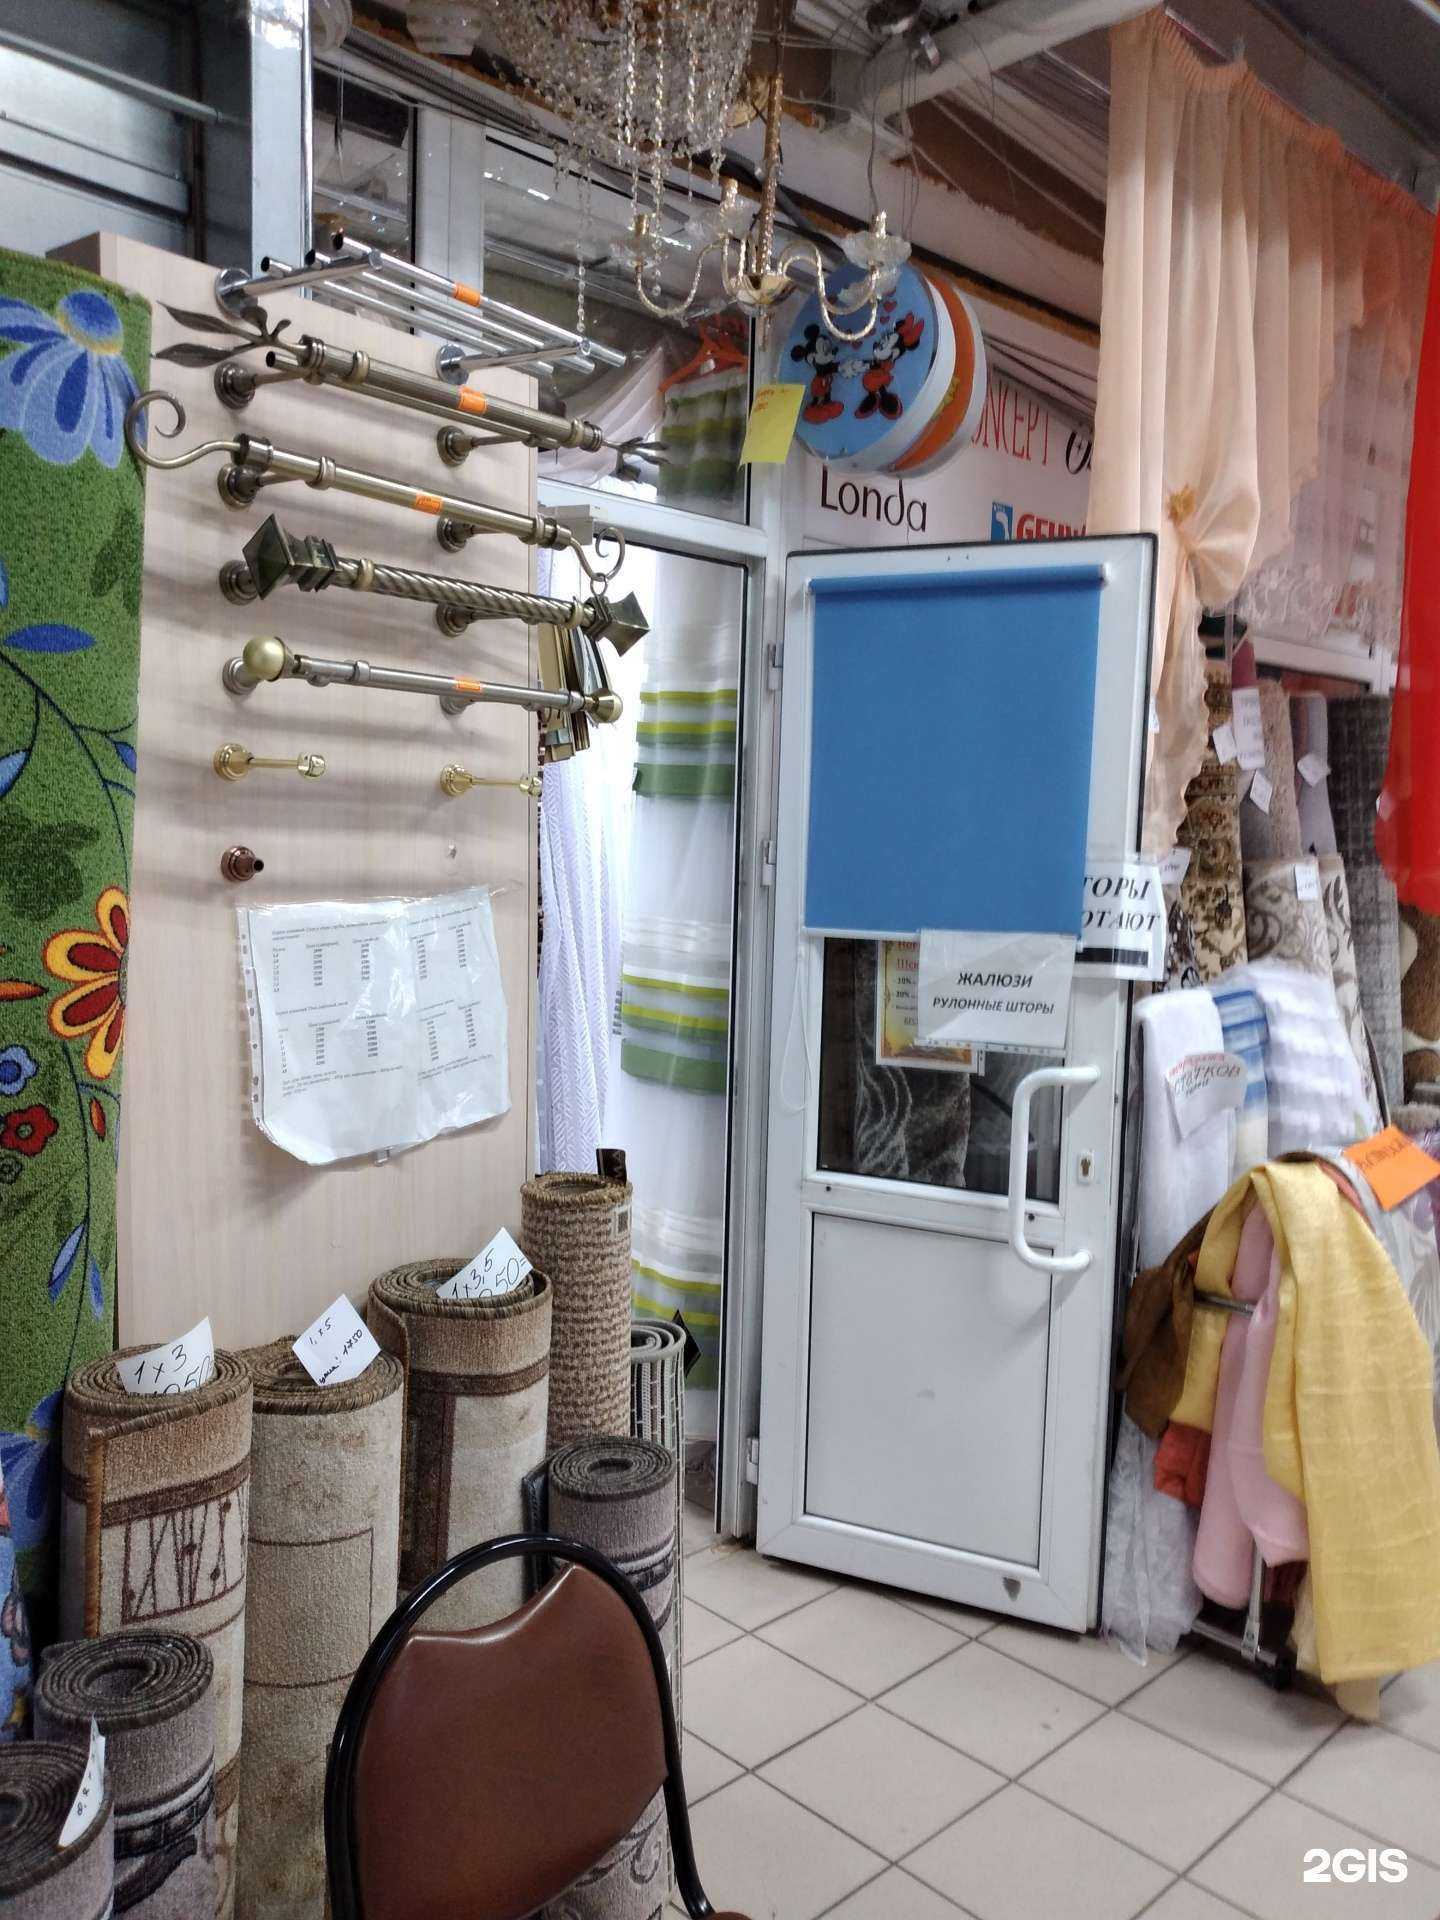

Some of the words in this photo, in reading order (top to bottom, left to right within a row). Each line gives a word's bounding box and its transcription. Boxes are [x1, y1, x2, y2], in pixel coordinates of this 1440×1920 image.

[821, 463, 927, 532] Londa
[957, 972, 1033, 988] ЖАЛЮЗИ
[933, 996, 1004, 1012] РУЛОННЫЕ
[1006, 1000, 1055, 1014] ШТОРЫ
